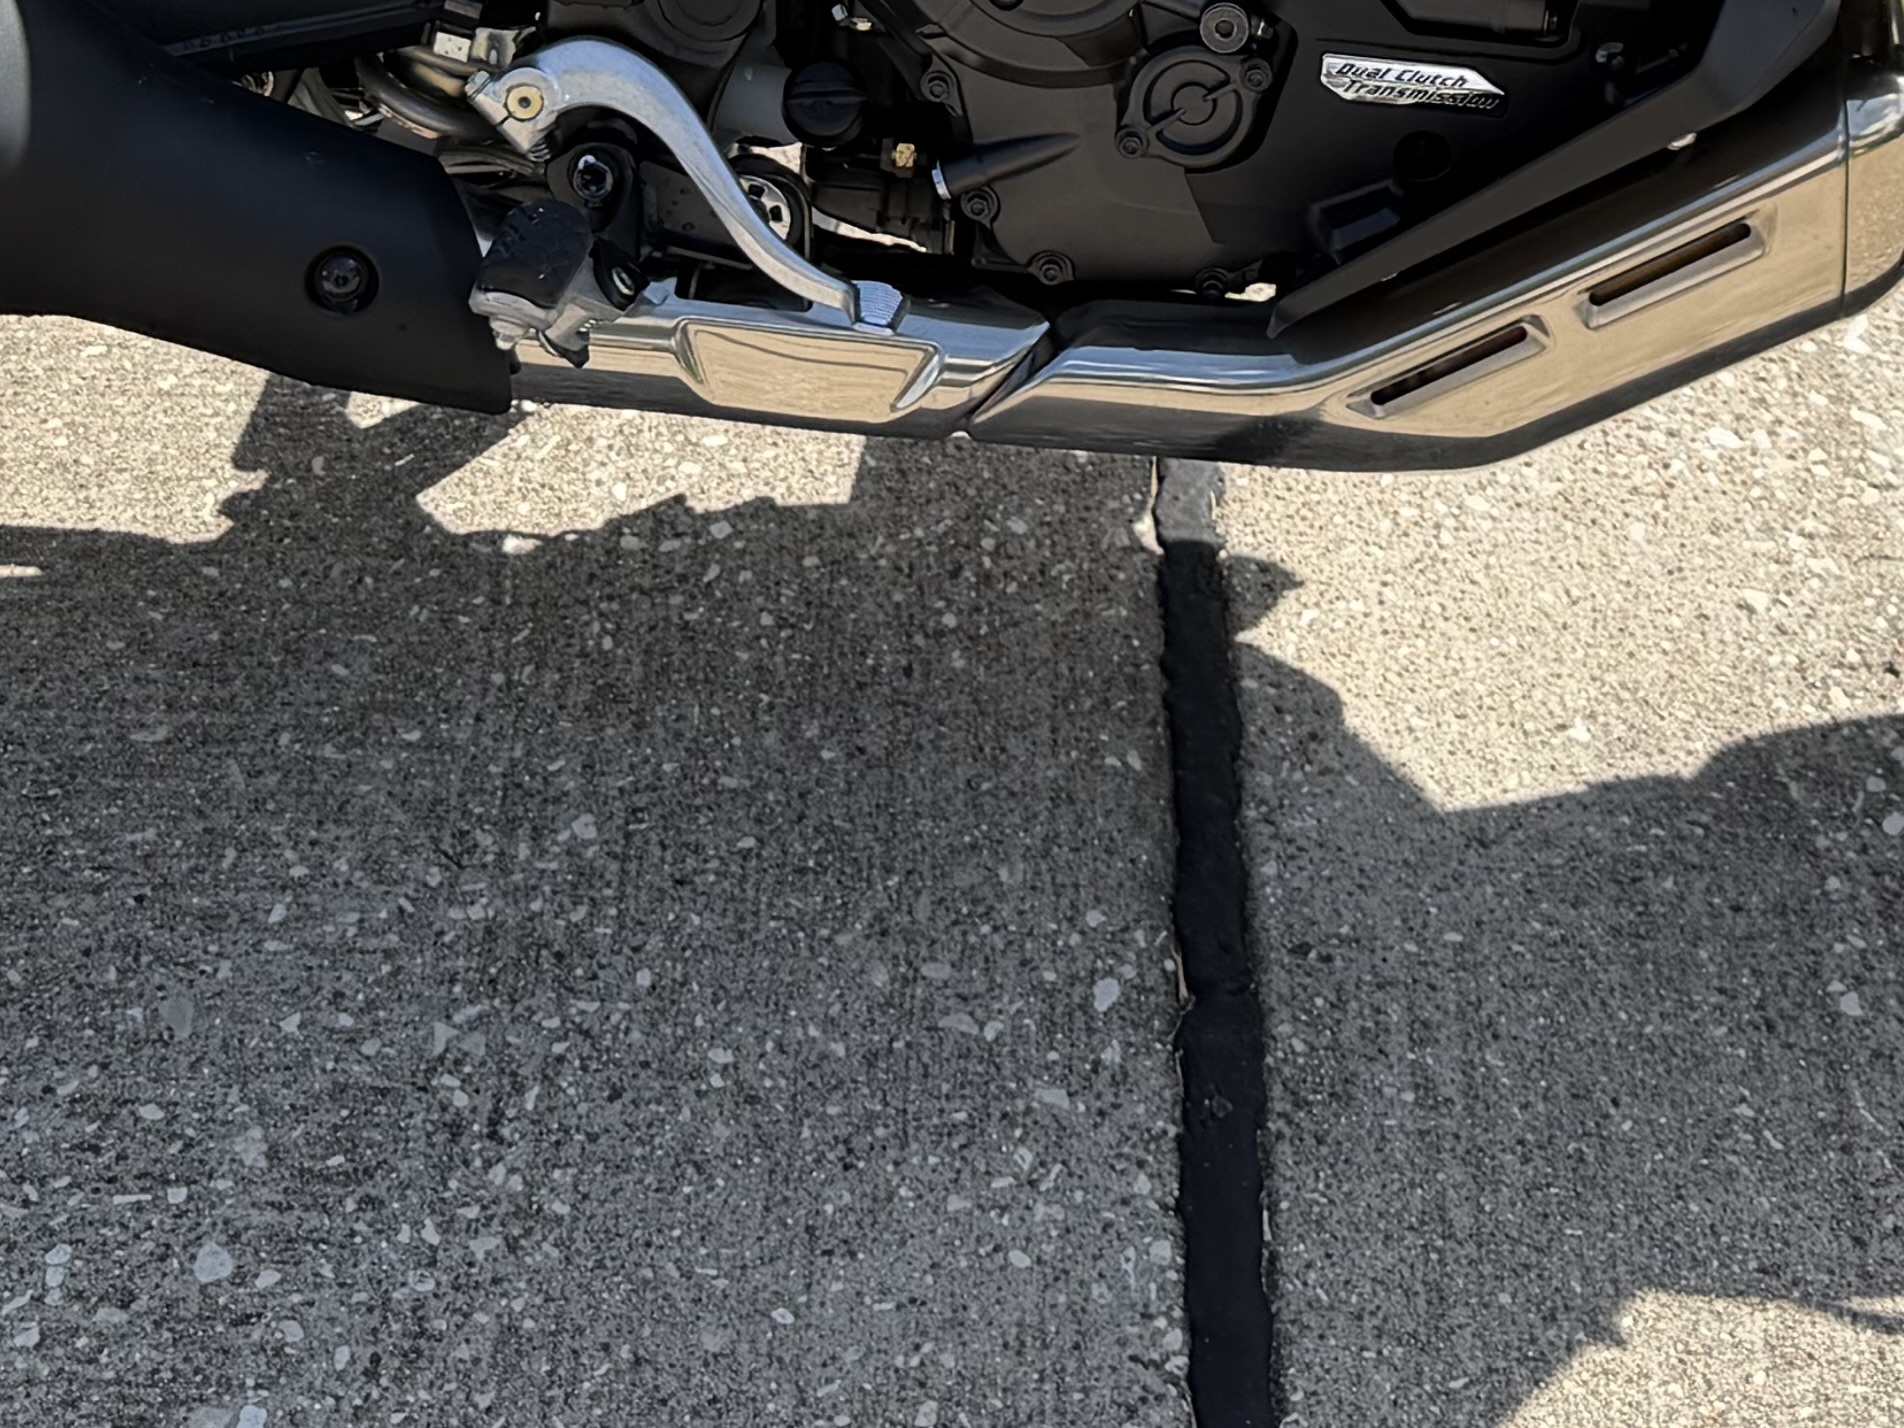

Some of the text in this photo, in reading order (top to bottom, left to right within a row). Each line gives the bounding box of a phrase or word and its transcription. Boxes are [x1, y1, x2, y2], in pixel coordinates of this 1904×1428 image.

[1335, 62, 1468, 88] Dual Clutch
[1344, 79, 1499, 110] Transmission
